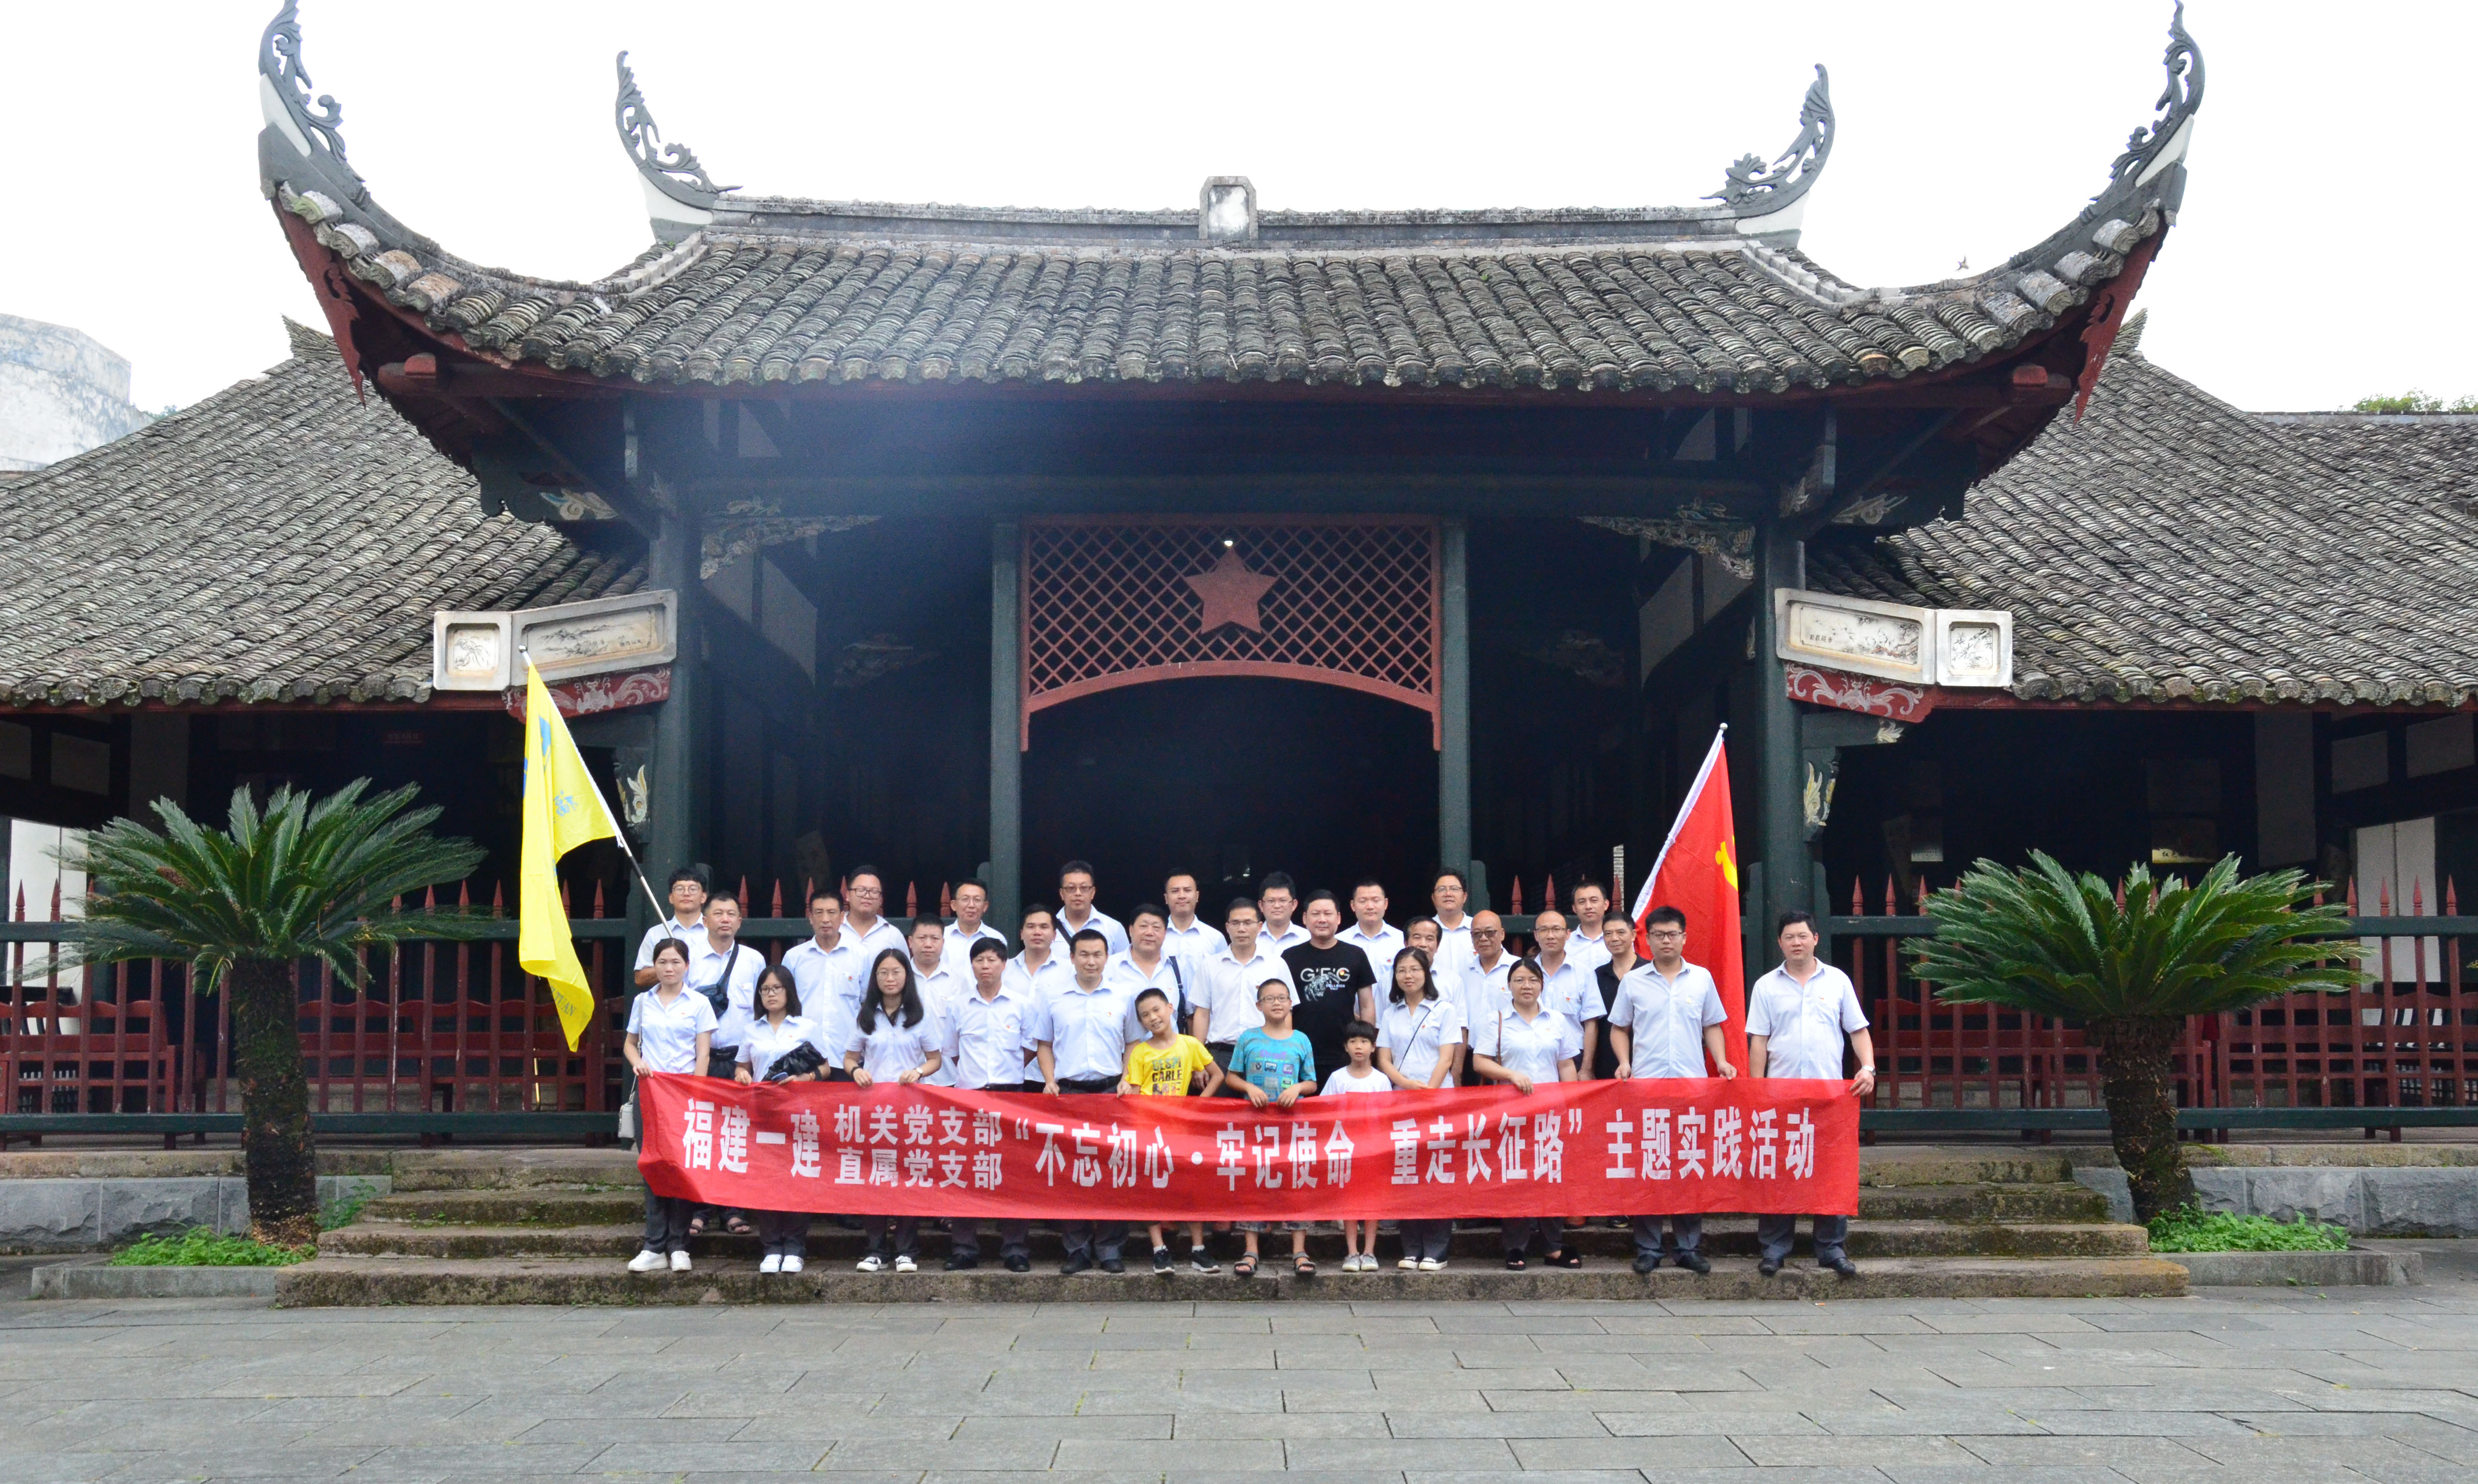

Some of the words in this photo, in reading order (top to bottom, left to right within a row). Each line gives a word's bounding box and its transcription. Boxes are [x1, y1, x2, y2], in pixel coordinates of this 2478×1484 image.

[1152, 1069, 1182, 1082] CABLE
[682, 1098, 822, 1178] 福建一建
[834, 1104, 1002, 1147] 机关党支部
[1606, 1106, 1815, 1180] 主题实践活动
[834, 1146, 1002, 1190] 直属党支部
